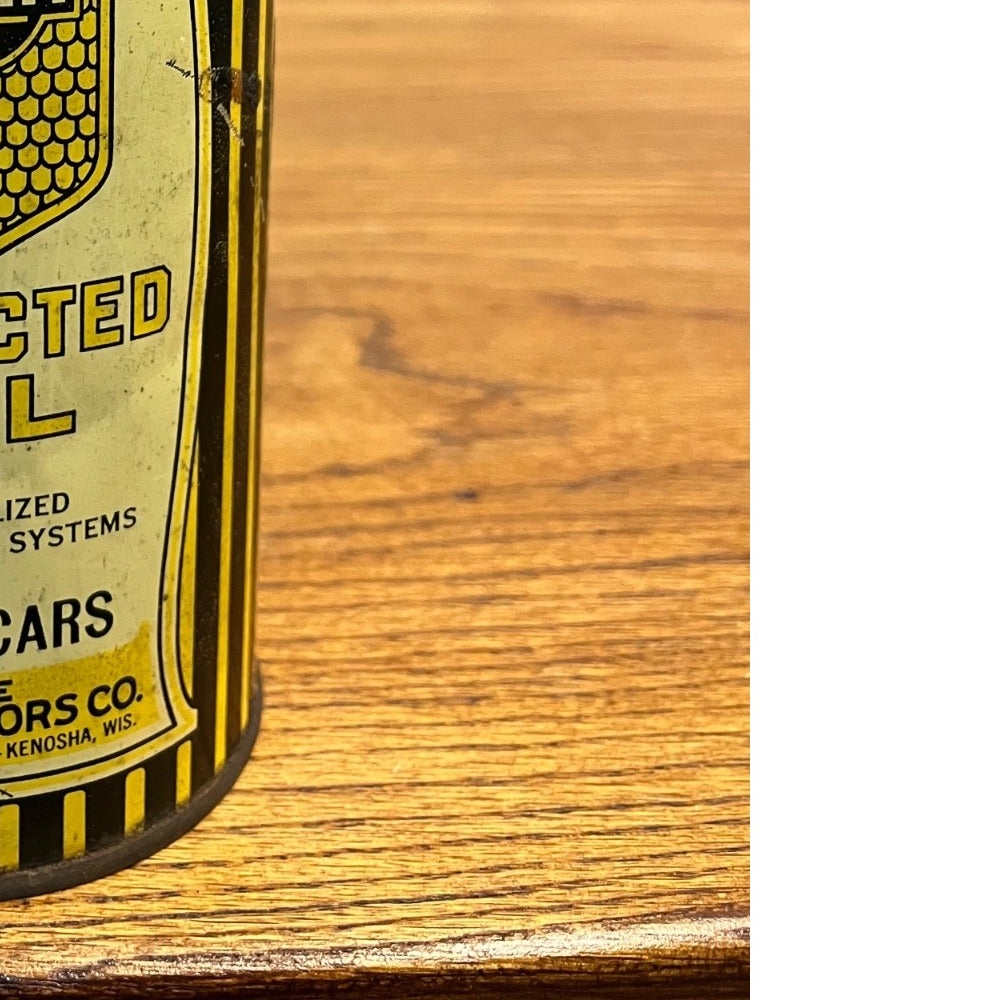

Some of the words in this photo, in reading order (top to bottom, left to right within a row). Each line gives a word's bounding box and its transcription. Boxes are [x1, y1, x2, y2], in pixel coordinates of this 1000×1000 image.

[9, 507, 137, 554] SYSTEMS
[87, 676, 144, 717] CO.
[103, 714, 137, 737] WIS.
